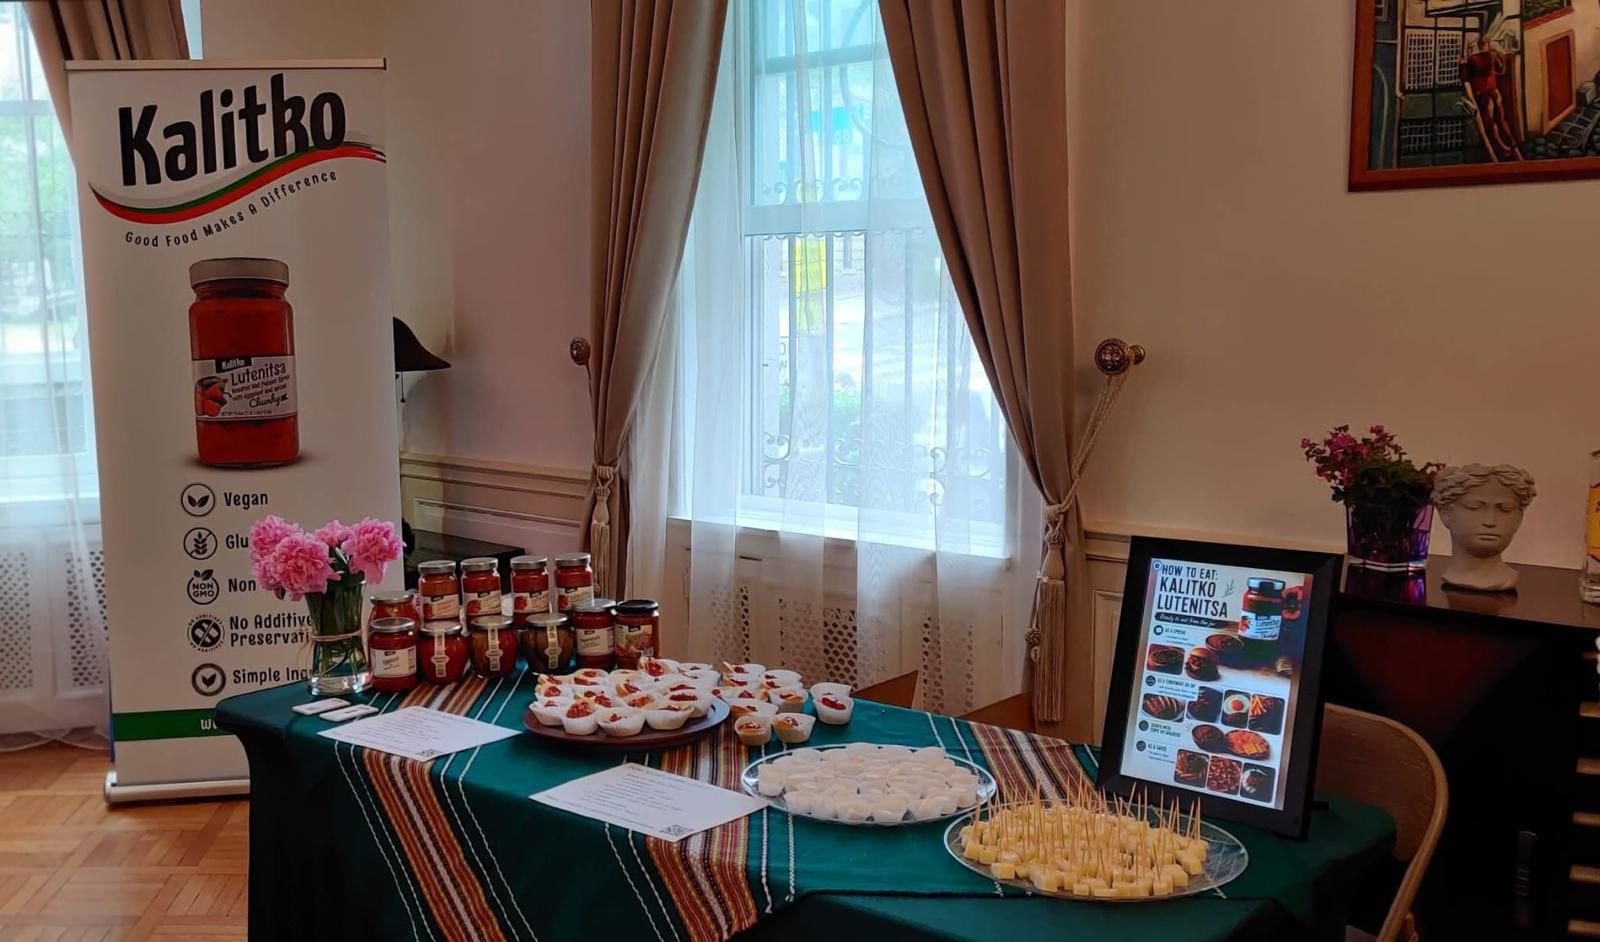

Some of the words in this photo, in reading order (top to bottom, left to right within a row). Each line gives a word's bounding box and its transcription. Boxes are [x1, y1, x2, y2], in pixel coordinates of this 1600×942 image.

[118, 73, 346, 186] Kalitko
[125, 231, 159, 247] Good
[165, 229, 198, 247] Food
[203, 209, 244, 237] Makes
[248, 203, 258, 216] A
[260, 171, 337, 208] Difference
[230, 362, 287, 386] Lutenitsa
[249, 393, 280, 407] Chunky
[223, 492, 269, 510] Vegan
[225, 533, 249, 549] Glu
[1161, 564, 1183, 577] HOW
[1186, 566, 1197, 578] TO
[1200, 568, 1219, 581] EAT:
[192, 582, 214, 590] NON
[192, 590, 215, 598] GMO
[228, 578, 257, 593] Non
[1159, 576, 1217, 598] KALITKO
[1156, 593, 1228, 618] LUTENITSA
[229, 615, 249, 630] No
[254, 612, 313, 629] Additive
[230, 630, 310, 647] Preservati
[233, 668, 281, 685] Simple
[286, 667, 313, 681] Ing
